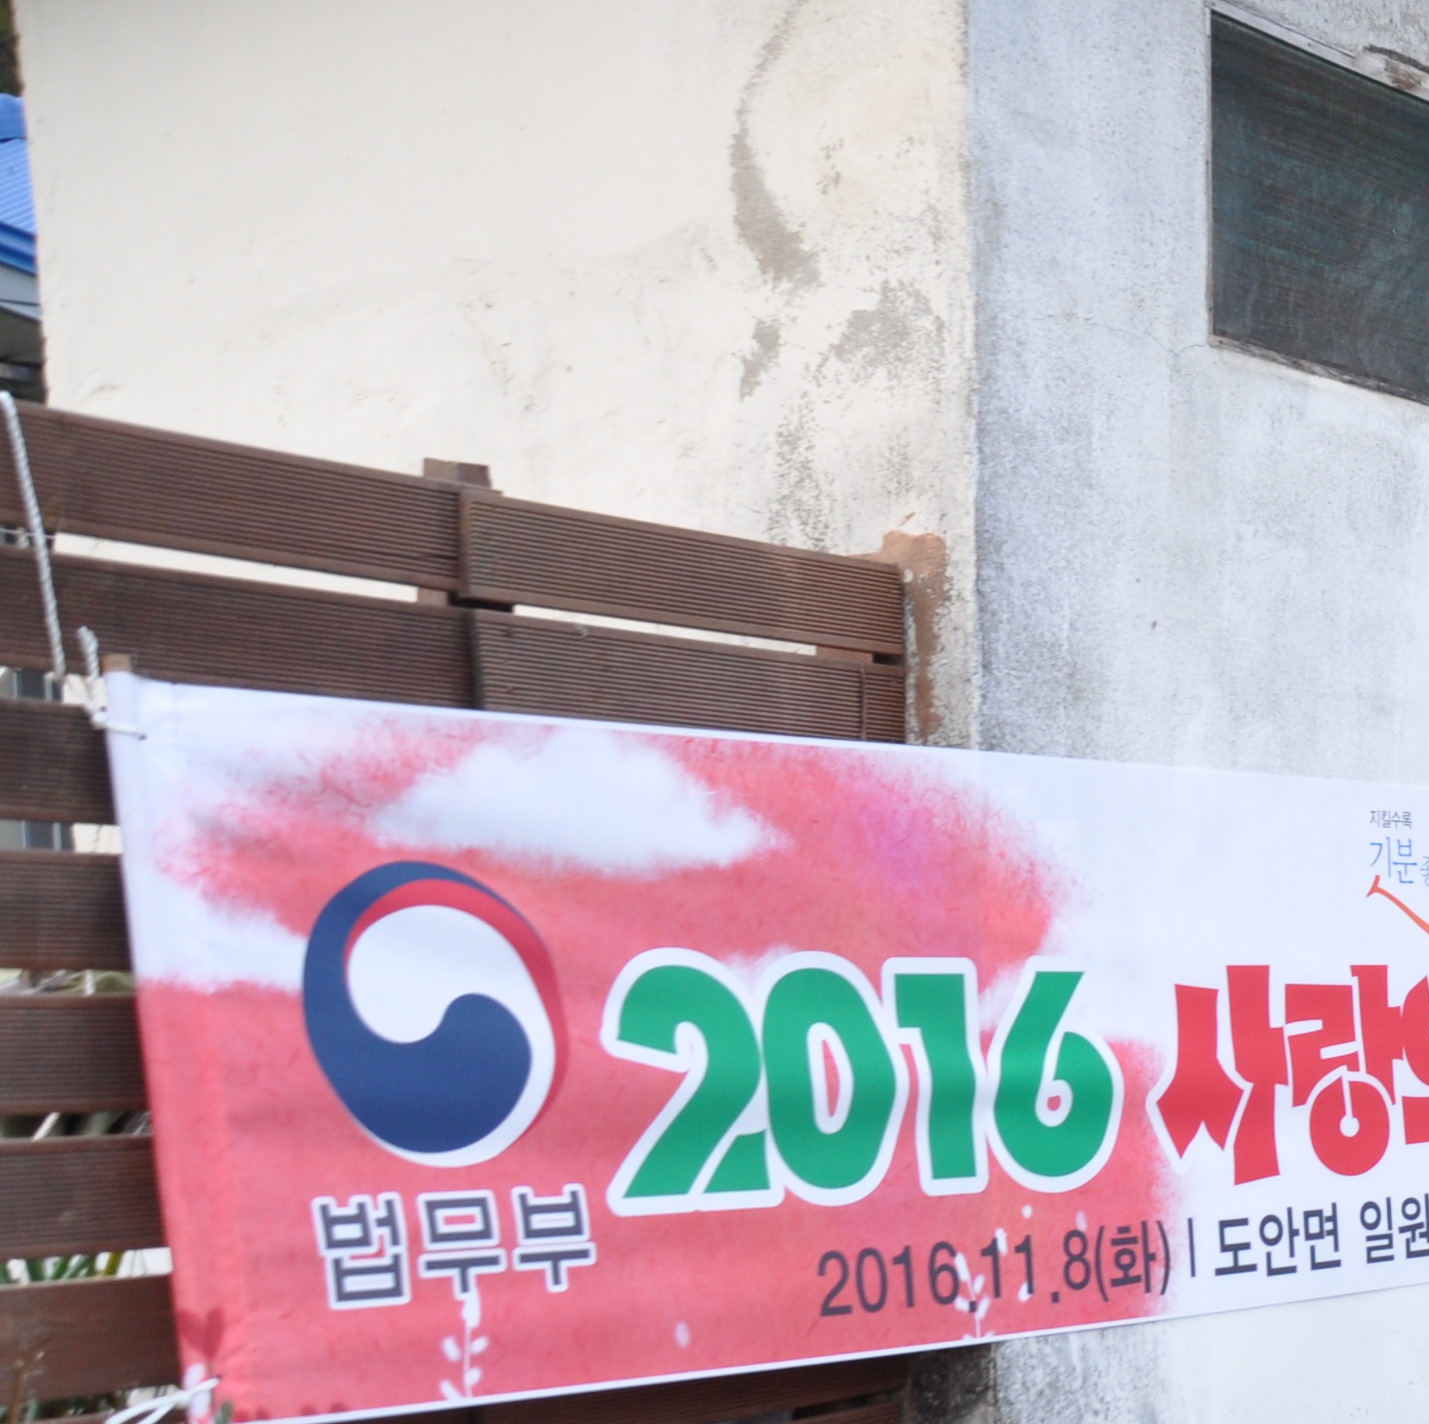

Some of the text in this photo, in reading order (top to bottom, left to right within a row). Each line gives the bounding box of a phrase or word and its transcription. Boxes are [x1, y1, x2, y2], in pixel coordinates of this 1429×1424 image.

[1369, 809, 1412, 829] 지킬수록
[1369, 836, 1418, 884] 기분
[614, 962, 1117, 1201] 2016
[317, 1187, 594, 1304] 법무부
[816, 1219, 1172, 1318] 2016.11.8(화)
[1214, 1201, 1342, 1277] 도안면
